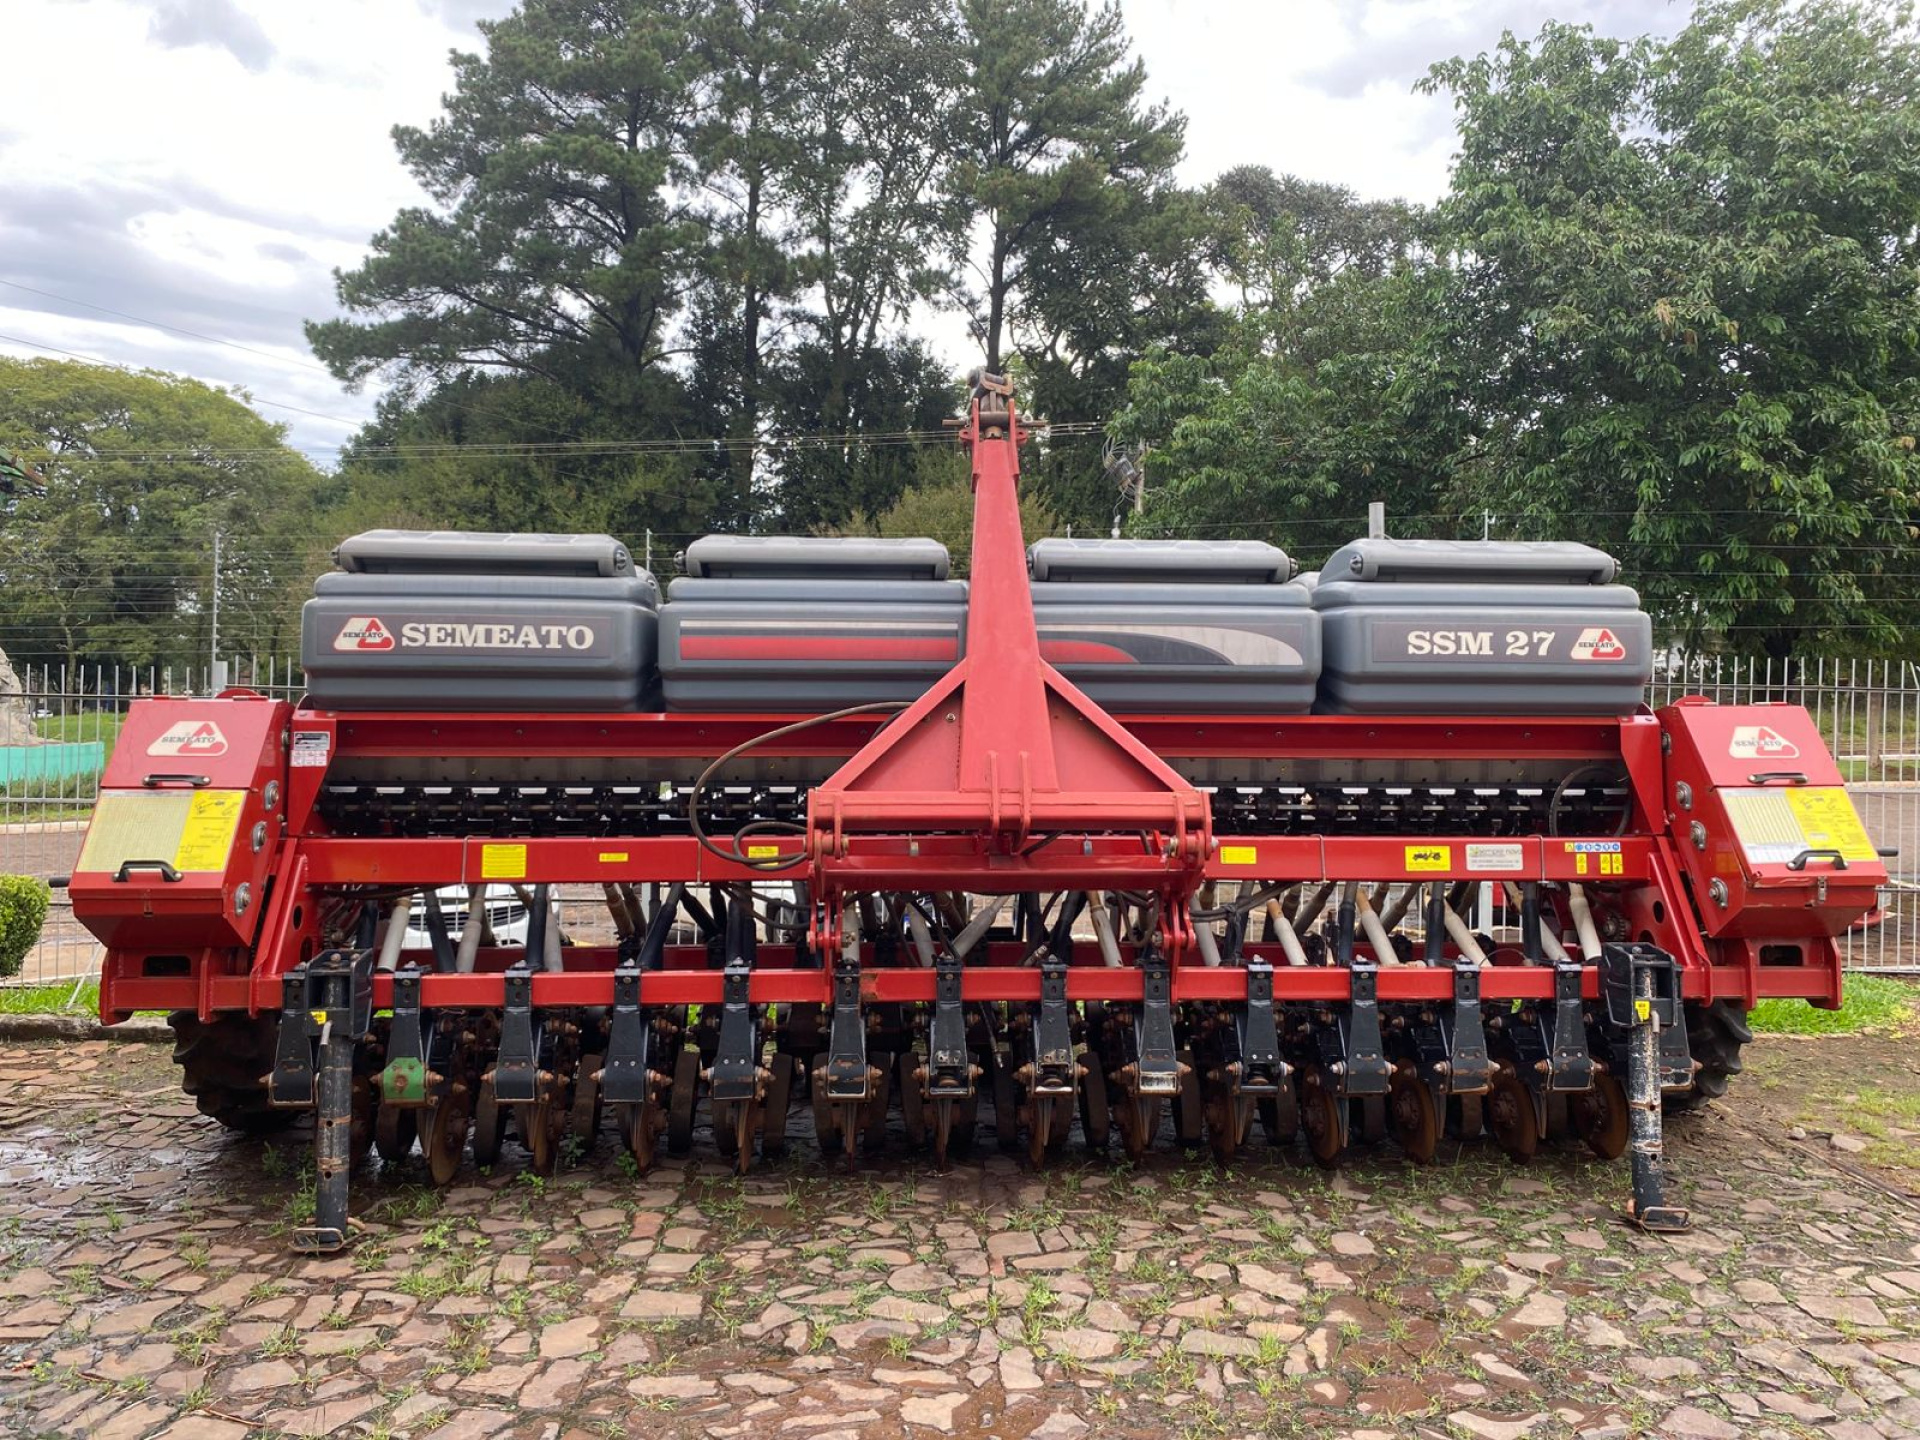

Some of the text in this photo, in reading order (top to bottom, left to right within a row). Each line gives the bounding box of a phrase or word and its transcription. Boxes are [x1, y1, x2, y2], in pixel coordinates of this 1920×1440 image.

[401, 623, 595, 650] SEMEATO
[1407, 630, 1556, 656] SSM 27
